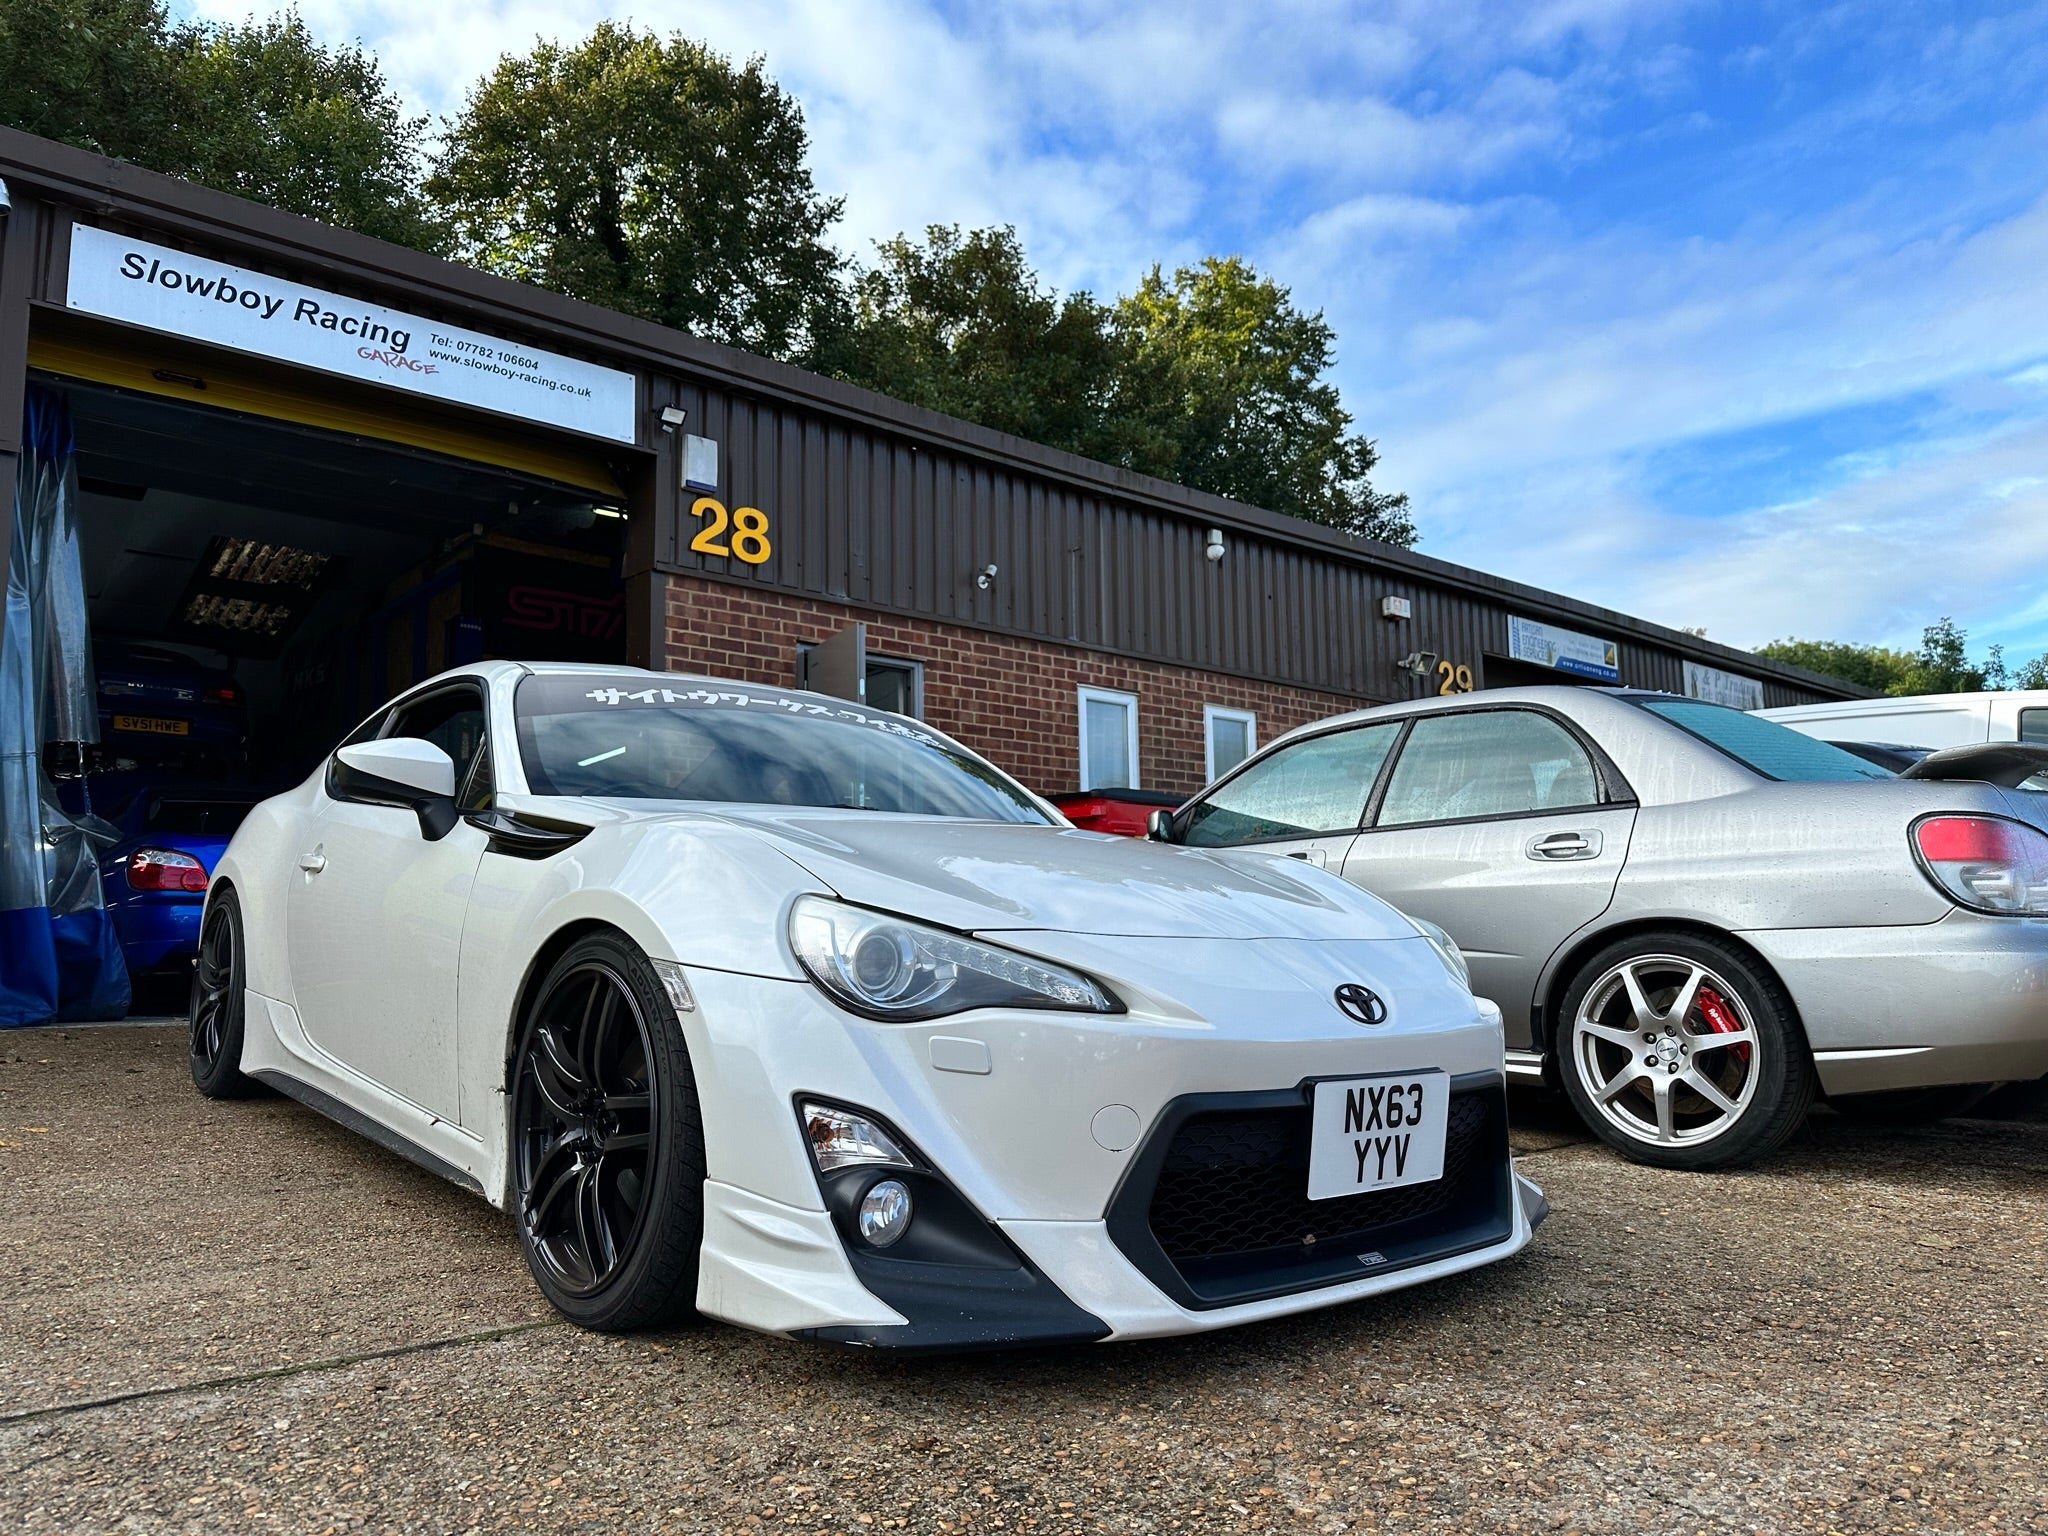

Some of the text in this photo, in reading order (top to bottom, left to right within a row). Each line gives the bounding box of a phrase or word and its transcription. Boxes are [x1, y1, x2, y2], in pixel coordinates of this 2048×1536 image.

[120, 252, 411, 354] Slowboy Racing
[357, 346, 439, 375] GARAGE
[429, 349, 592, 398] www.slowboy-racing.co.uk
[430, 333, 539, 371] Tel: 07782 106604
[690, 497, 772, 564] 28
[1438, 660, 1473, 696] 29
[631, 967, 658, 1025] ADVAN
[1344, 1083, 1423, 1134] NX63
[1354, 1133, 1411, 1184] YYV
